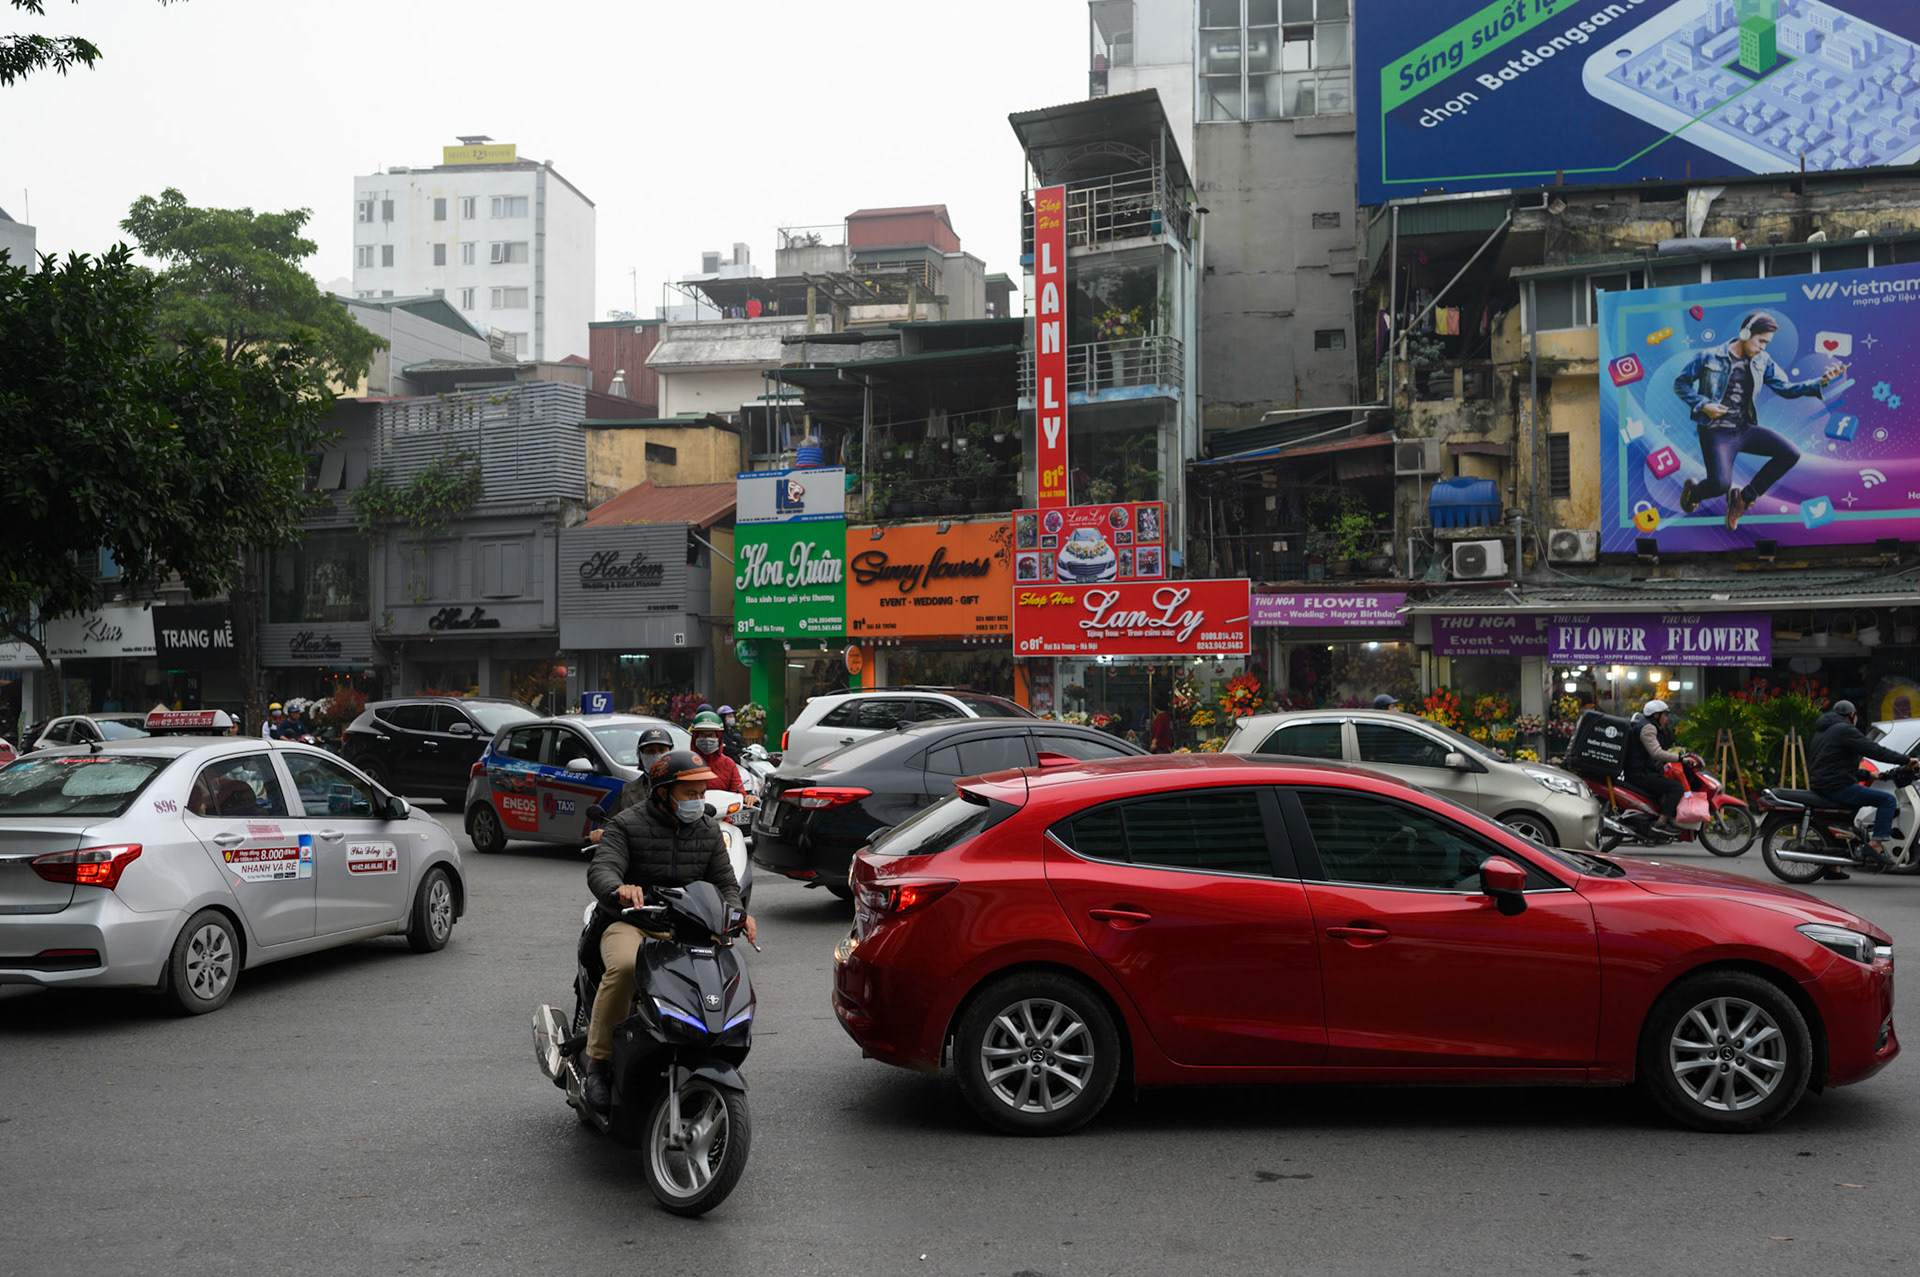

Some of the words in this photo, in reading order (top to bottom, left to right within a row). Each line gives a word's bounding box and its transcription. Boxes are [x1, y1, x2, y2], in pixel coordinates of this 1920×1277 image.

[1400, 40, 1463, 91] Sáng
[1419, 90, 1479, 128] chọn
[1037, 199, 1061, 212] Shop
[1039, 216, 1060, 229] Hoa
[736, 543, 784, 590] Hoa
[786, 541, 842, 588] Xuân
[851, 550, 924, 593] Sunny
[922, 546, 990, 588] flowers
[759, 595, 772, 603] xinh
[774, 595, 786, 603] trao
[880, 598, 906, 607] EVENT
[914, 596, 953, 606] WEDDING
[960, 596, 979, 605] GIFT
[1019, 592, 1047, 608] Shop
[1050, 591, 1075, 605] Hoa
[1255, 598, 1272, 606] THU
[1275, 597, 1295, 605] NGA
[1304, 598, 1378, 608] FLOWER
[1330, 610, 1357, 619] Happy
[1360, 610, 1397, 619] Birthday
[1553, 615, 1571, 623] THU
[1573, 615, 1590, 624] NGA
[1662, 615, 1679, 624] THU
[1681, 616, 1700, 624] NGA
[1441, 617, 1475, 628] THU
[1479, 617, 1516, 628] NGA
[83, 617, 123, 642] Kim
[162, 629, 209, 648] TRANG
[675, 635, 683, 644] 81
[1450, 635, 1493, 645] Event
[1559, 627, 1646, 651] FLOWER
[1668, 627, 1760, 651] FLOWER
[592, 694, 607, 711] G7
[153, 799, 177, 813] 896
[503, 797, 536, 812] ENEOS
[557, 800, 574, 811] TAXI
[261, 849, 284, 860] 8.000
[241, 864, 271, 873] NHANH
[273, 861, 284, 872] VÀ
